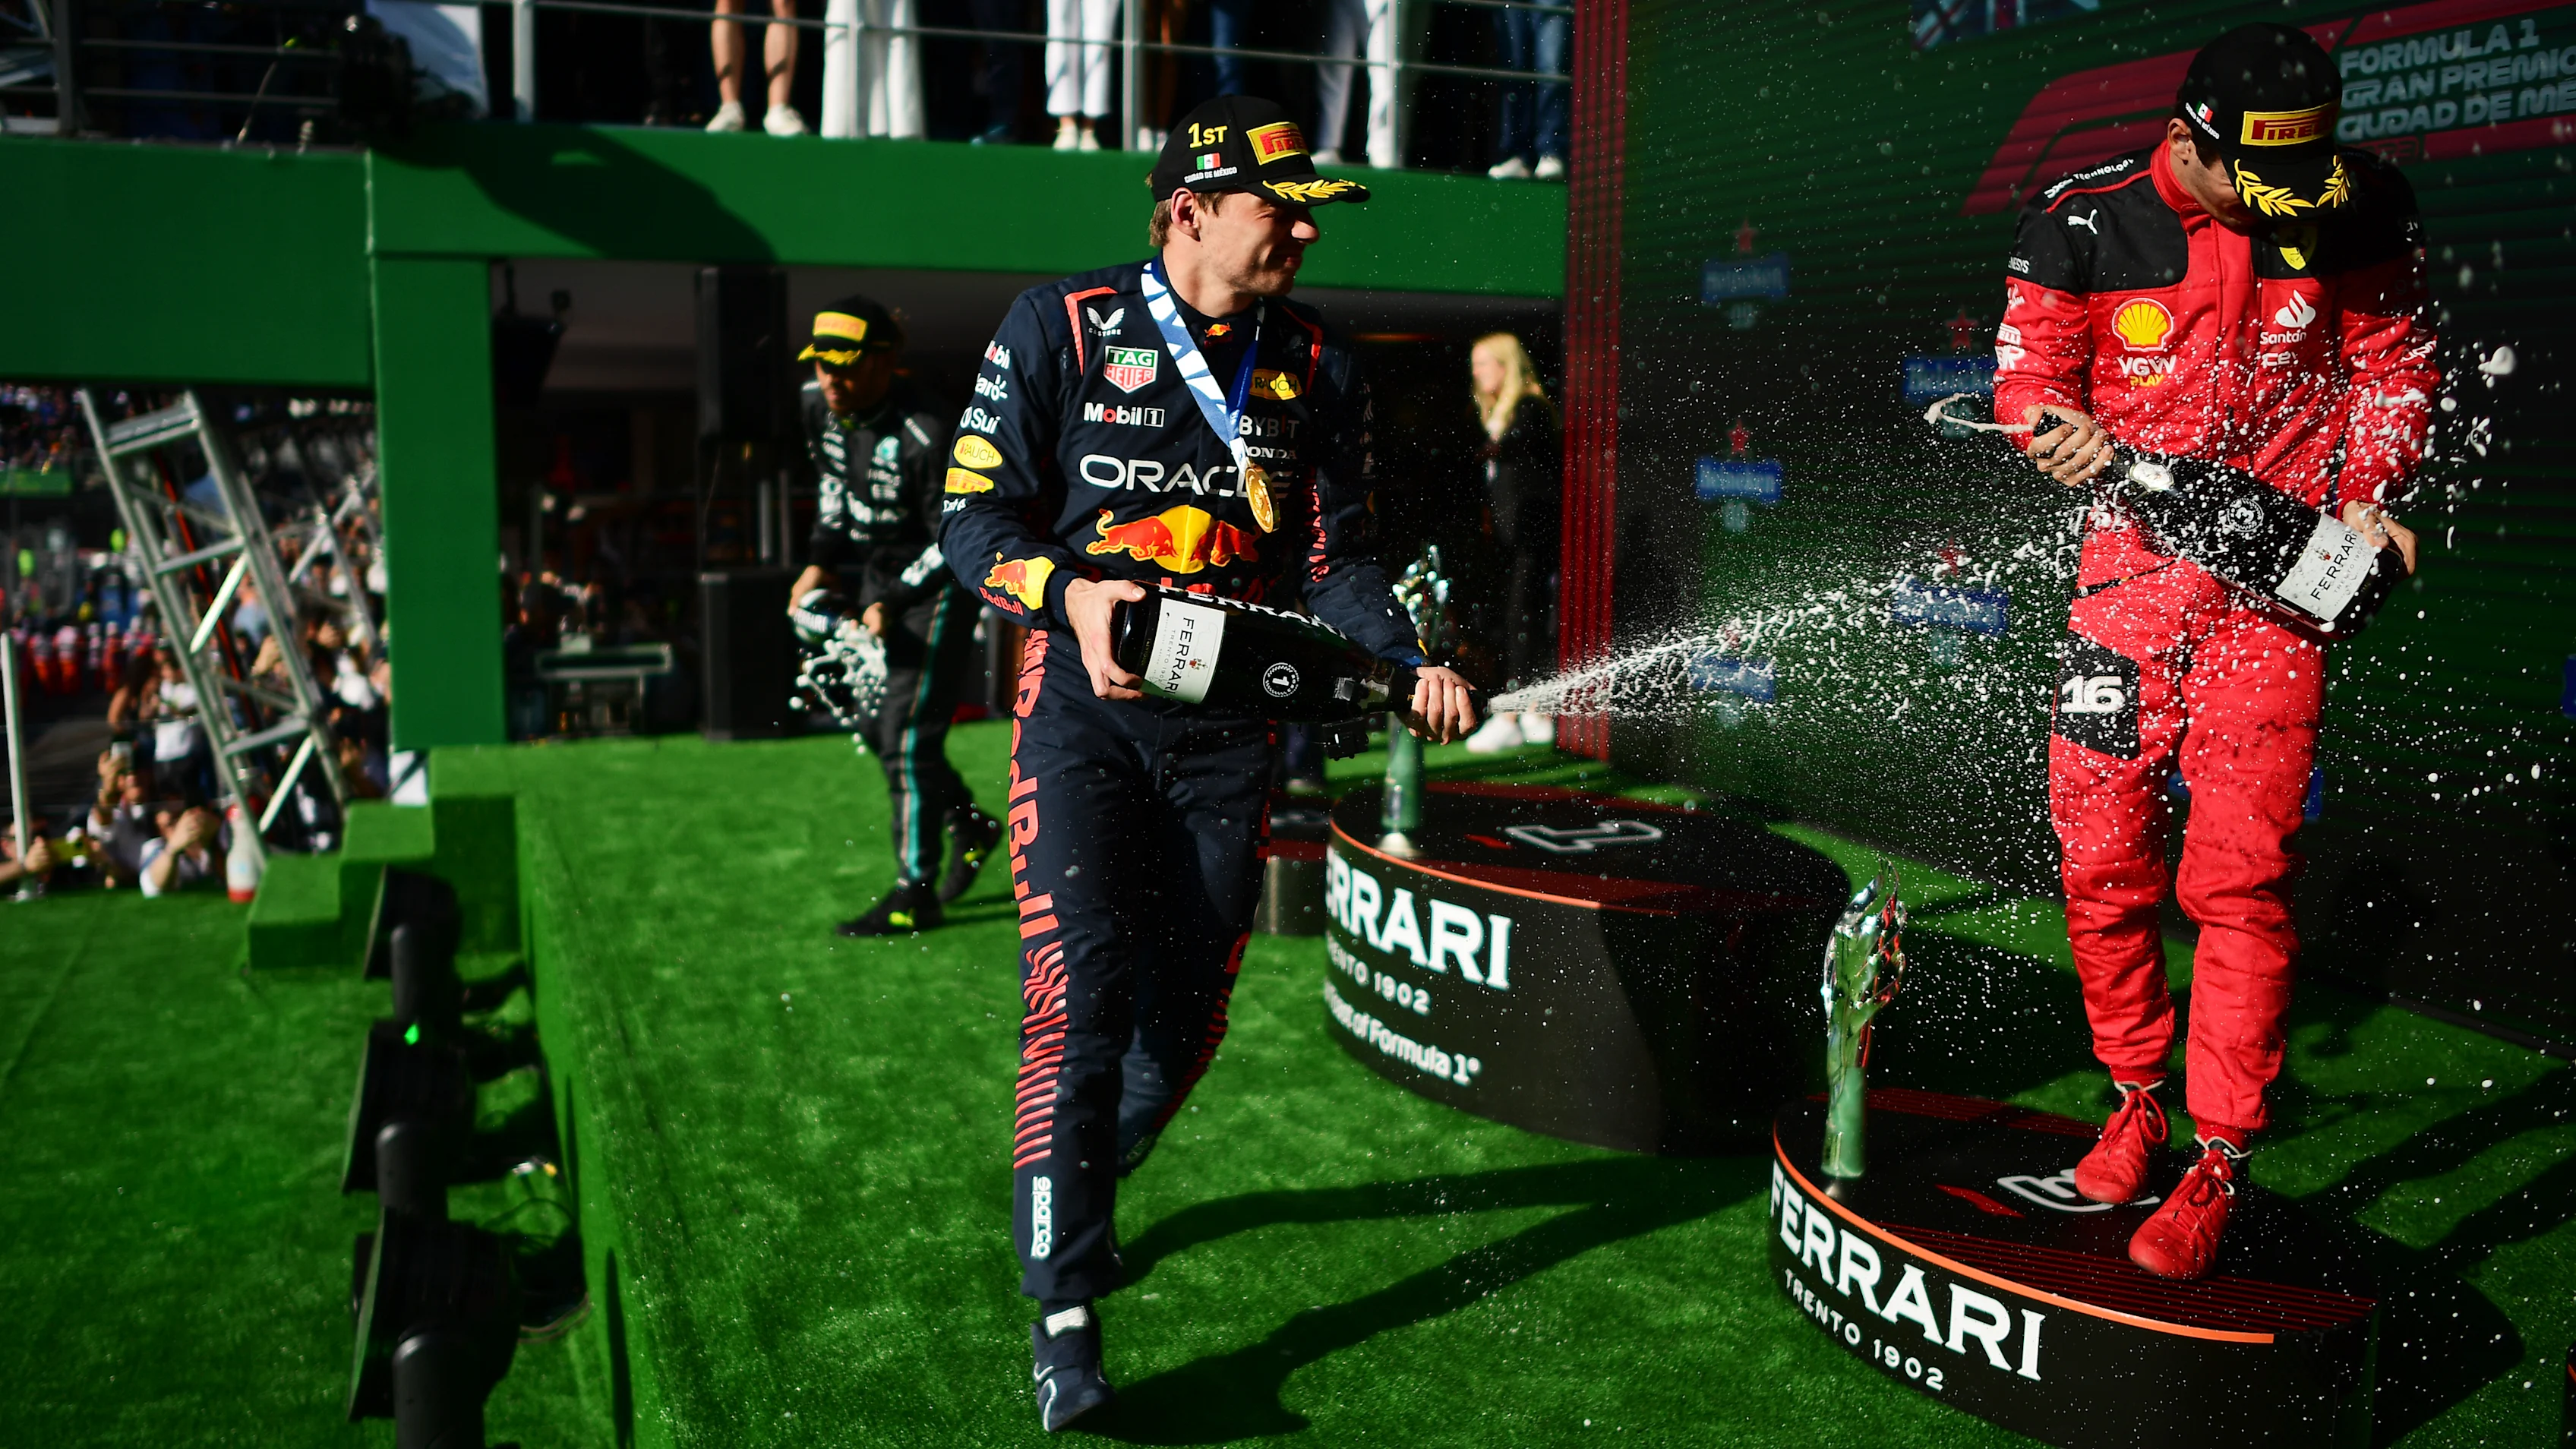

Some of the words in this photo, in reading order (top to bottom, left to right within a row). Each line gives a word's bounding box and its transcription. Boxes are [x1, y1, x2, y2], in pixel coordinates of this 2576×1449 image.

[2339, 24, 2512, 78] FORMULA
[2518, 18, 2541, 49] 1
[2341, 69, 2436, 111] GRAN
[2439, 46, 2576, 95] PREMIO
[2335, 99, 2458, 142] CIUDAD
[2462, 90, 2514, 125] DE
[1188, 122, 1228, 149] 1ST
[1204, 171, 1214, 179] DE
[2072, 158, 2135, 181] TECHNOLOGY
[1088, 327, 1122, 337] CASTORE
[2259, 329, 2307, 346] Santan
[1110, 349, 1153, 367] TAG
[2115, 354, 2177, 377] VGW
[1106, 365, 1154, 390] HEUER
[1255, 377, 1298, 393] RAUCH
[2129, 374, 2165, 387] PLAY
[1084, 402, 1142, 426] Mobil
[1239, 415, 1301, 439] BYBIT
[1246, 445, 1298, 460] ONDA
[1079, 454, 1293, 500] ORACLE
[1163, 617, 1195, 695] FERRARI
[2061, 674, 2126, 713] 16
[1374, 971, 1431, 1016] 1902
[1368, 1018, 1452, 1079] Formula
[1031, 1175, 1053, 1260] sparco
[1770, 1159, 2047, 1381] FERRARI
[1784, 1267, 1861, 1346] TRENTO
[1872, 1338, 1945, 1392] 1902
